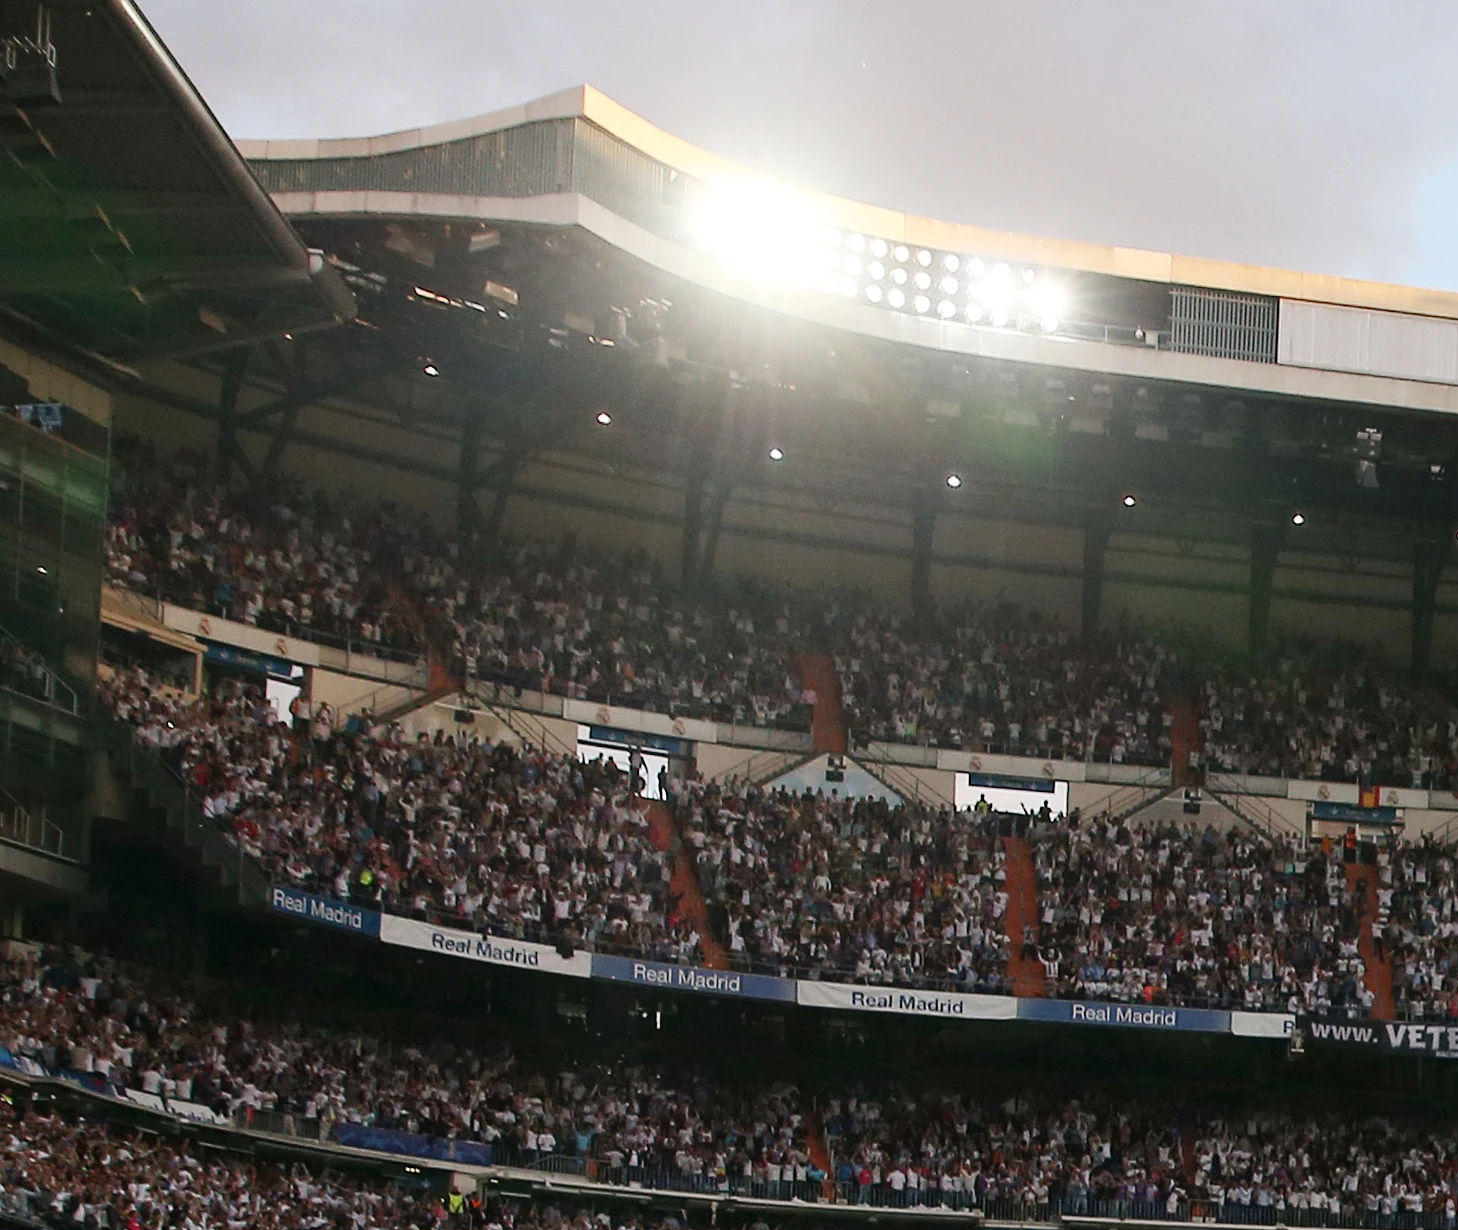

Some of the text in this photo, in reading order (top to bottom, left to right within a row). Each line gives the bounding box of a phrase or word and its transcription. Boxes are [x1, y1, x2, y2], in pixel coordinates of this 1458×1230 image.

[273, 889, 362, 929] Real Madrid
[431, 932, 539, 966] Real Madrid
[633, 963, 740, 992] Real Madrid
[851, 991, 964, 1015] Real Madrid
[1072, 1004, 1176, 1026] Real Madrid
[1311, 1021, 1378, 1044] www.
